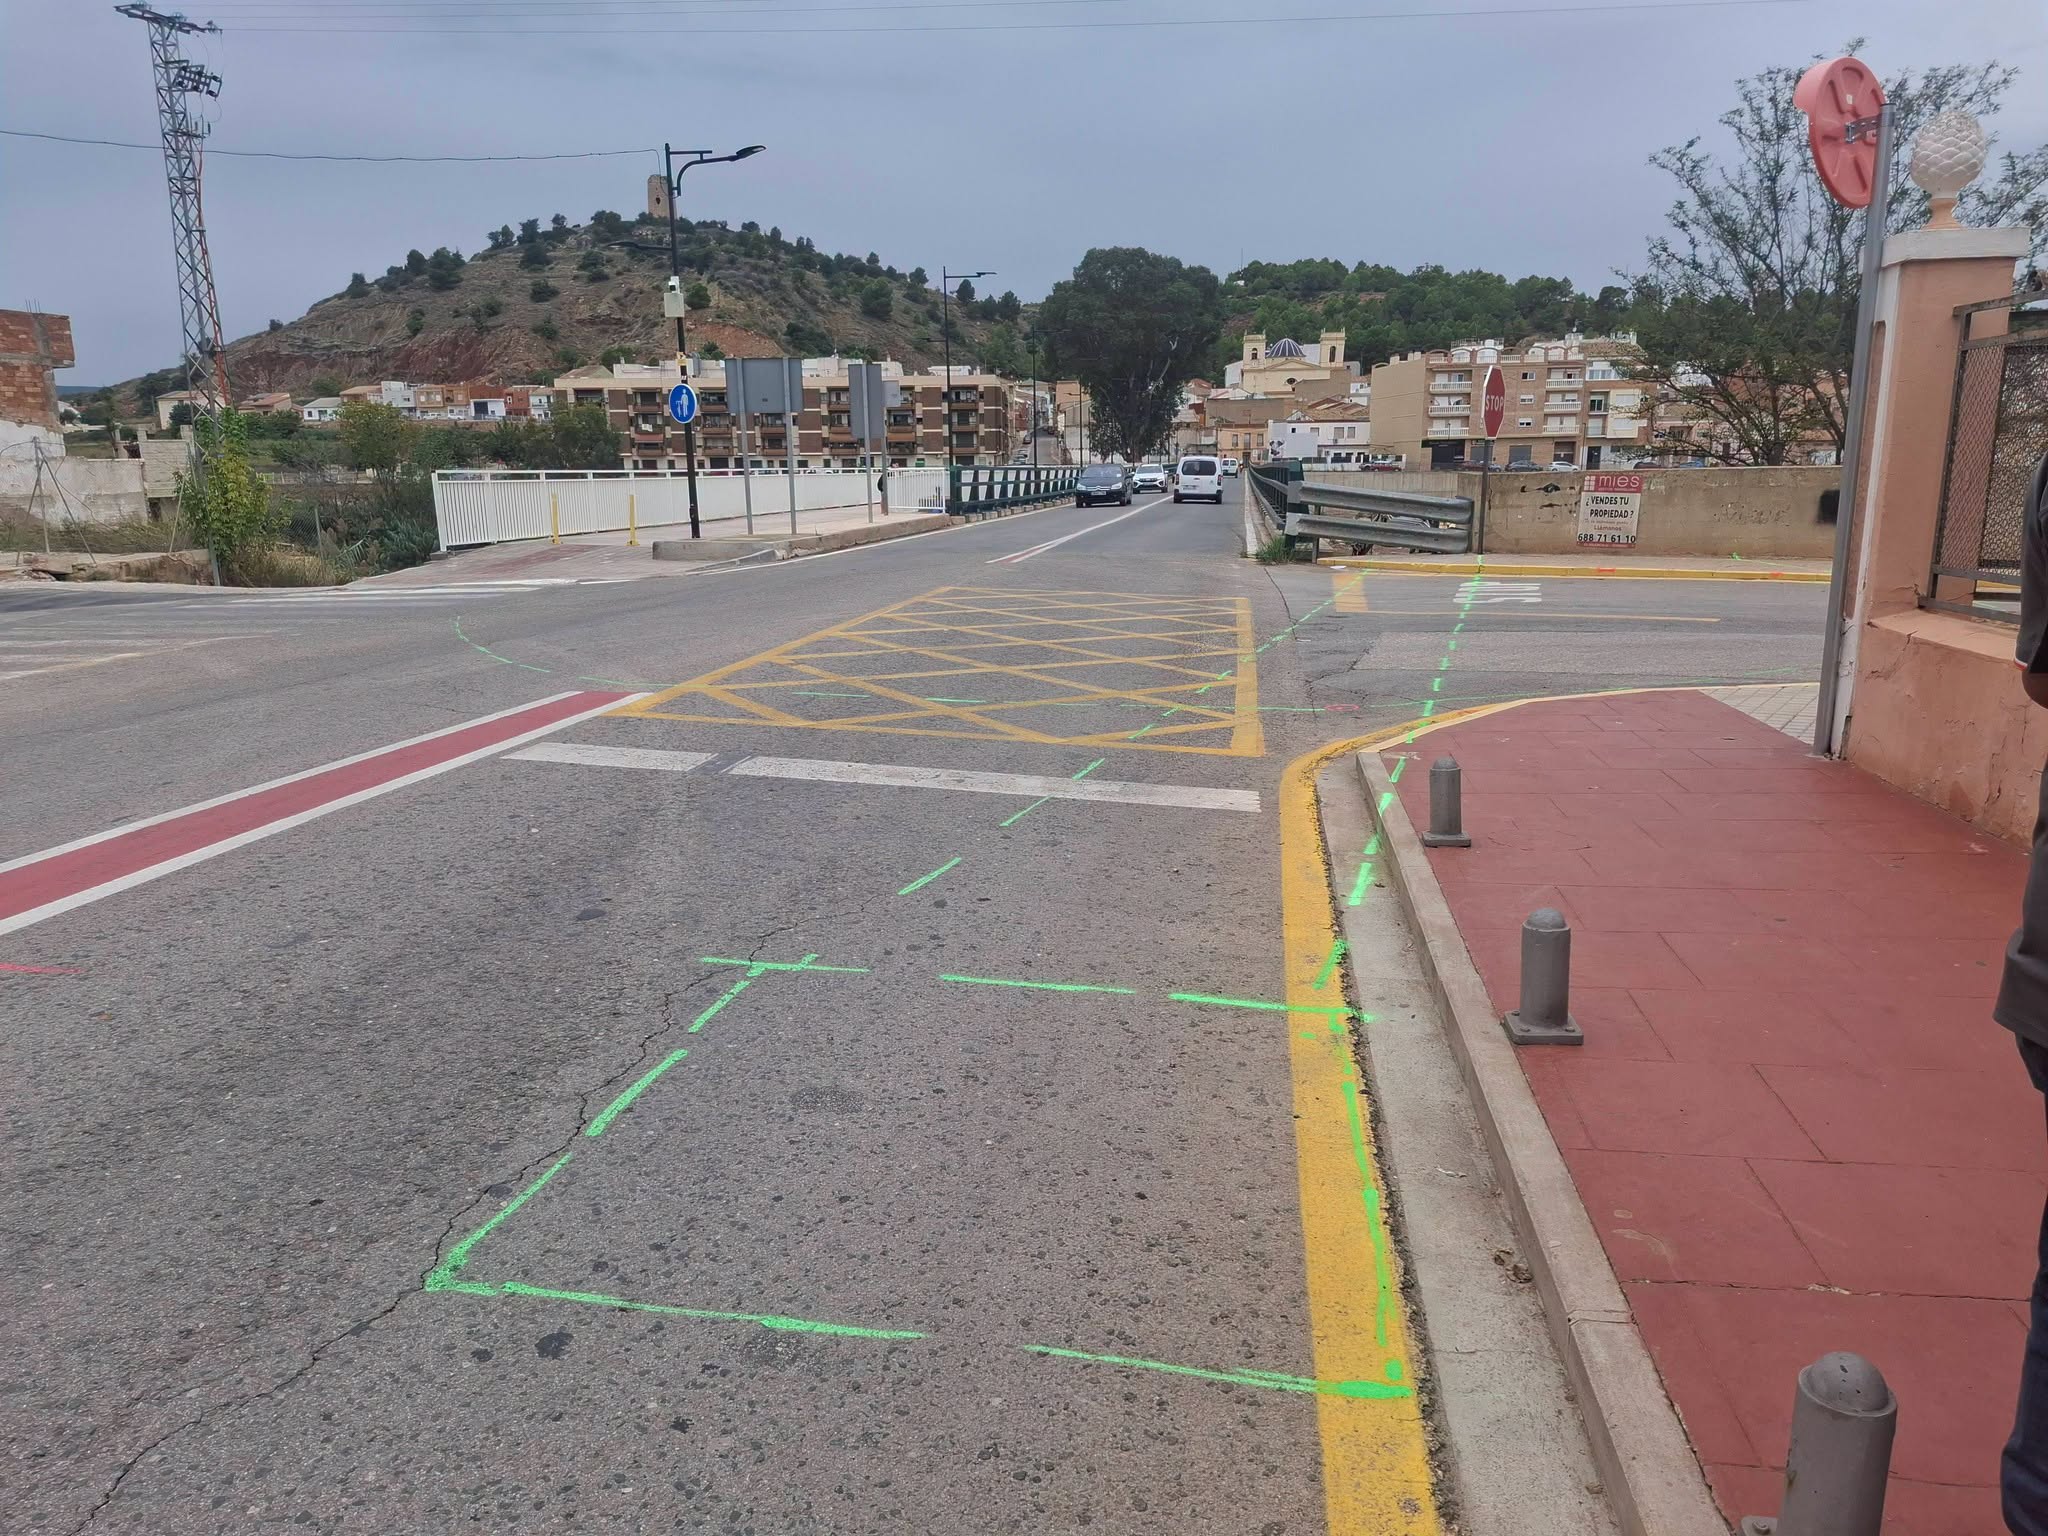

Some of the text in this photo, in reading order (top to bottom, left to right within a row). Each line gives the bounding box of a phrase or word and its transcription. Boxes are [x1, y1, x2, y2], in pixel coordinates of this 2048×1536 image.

[1485, 395, 1504, 412] STOP
[1599, 475, 1639, 487] mies
[1619, 496, 1629, 505] TU
[1578, 533, 1636, 543] 688 71 61 10
[1452, 581, 1542, 603] STOP
